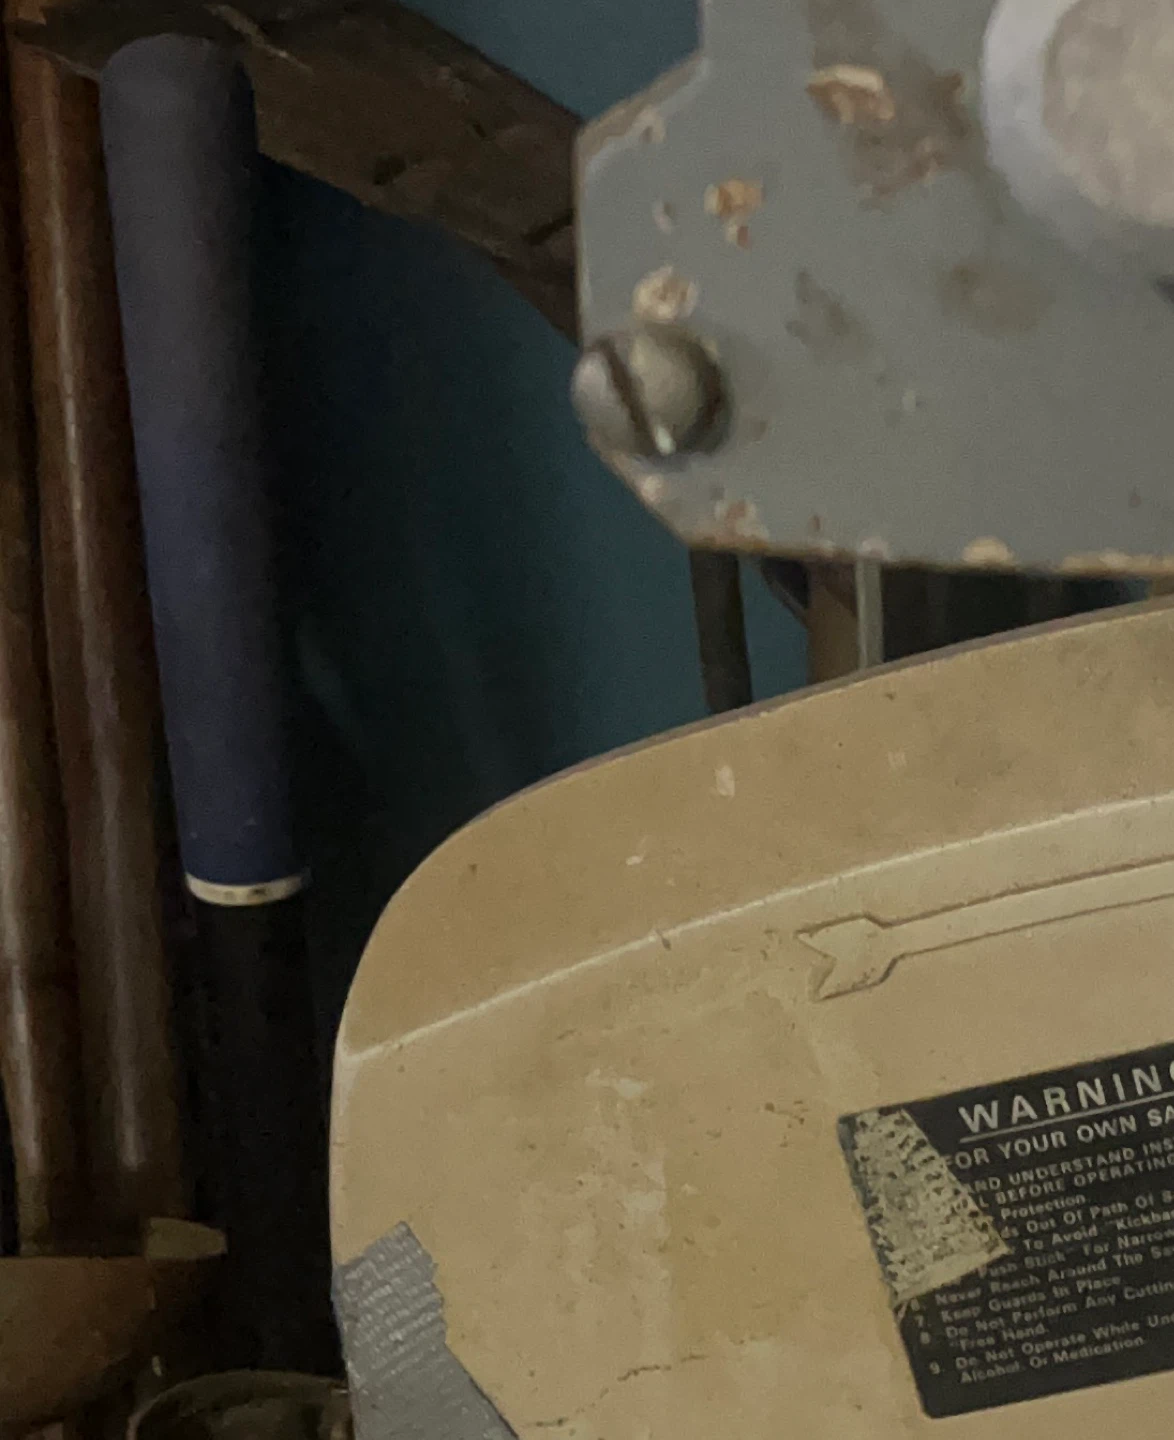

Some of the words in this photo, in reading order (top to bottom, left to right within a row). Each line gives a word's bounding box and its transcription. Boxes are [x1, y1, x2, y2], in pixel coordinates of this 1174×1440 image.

[996, 1129, 1067, 1159] YOUR
[1075, 1113, 1137, 1143] OWN
[1007, 1146, 1135, 1185] UNDERSTAND
[994, 1177, 1065, 1204] BEFORE
[1088, 1200, 1128, 1219] Path
[1050, 1223, 1098, 1246] Avoid
[934, 1286, 981, 1305] Never
[1047, 1256, 1107, 1282] Around
[1111, 1252, 1143, 1267] The
[987, 1291, 1046, 1312] Guards
[1011, 1302, 1077, 1324] Perform
[1020, 1332, 1086, 1355] Operate
[1091, 1320, 1140, 1340] While
